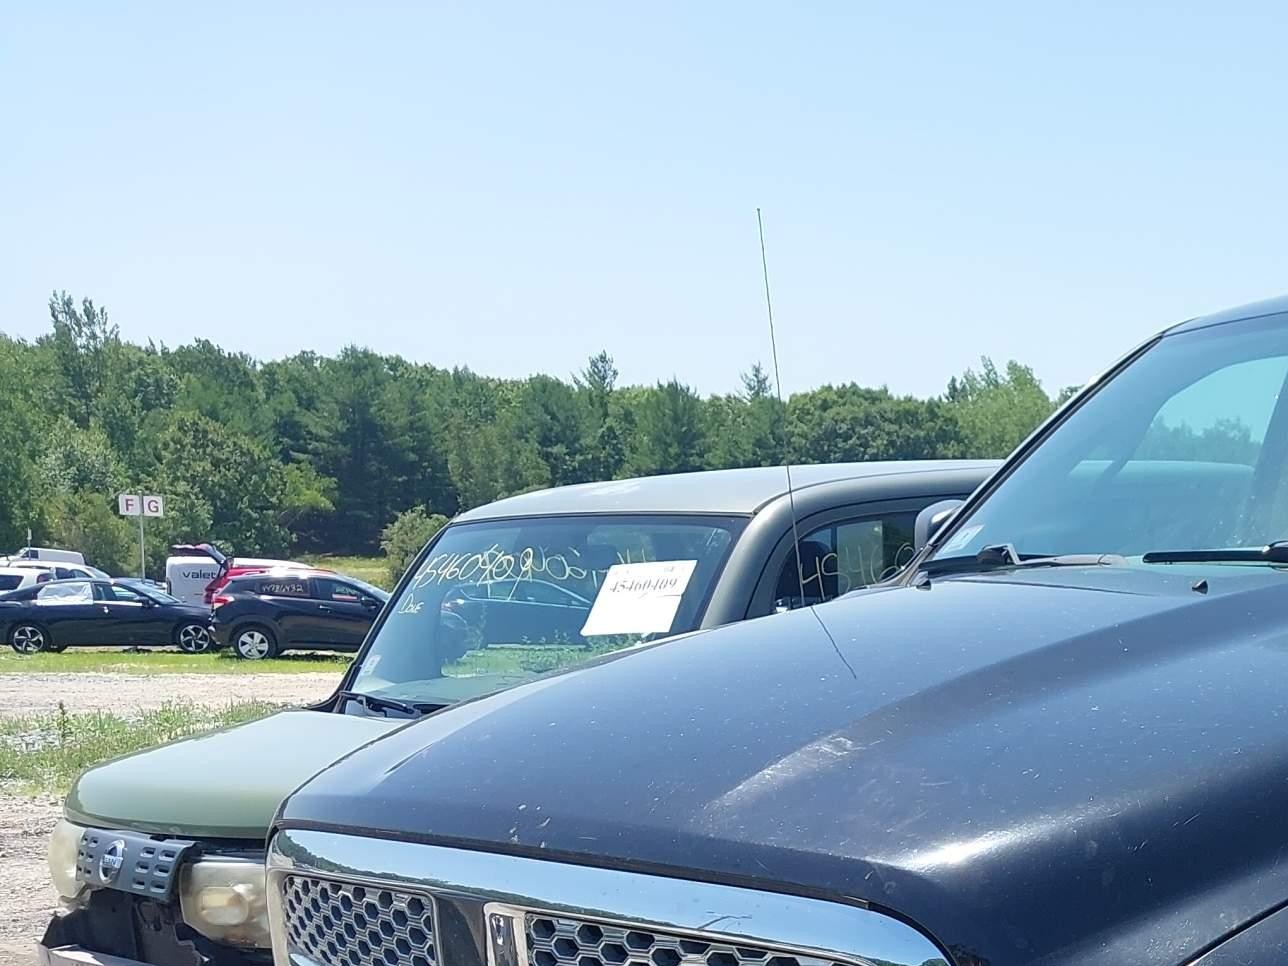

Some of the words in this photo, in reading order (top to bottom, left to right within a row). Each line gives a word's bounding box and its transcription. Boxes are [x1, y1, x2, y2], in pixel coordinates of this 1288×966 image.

[125, 498, 135, 512] F
[147, 499, 160, 513] G
[609, 577, 679, 593] 45460409
